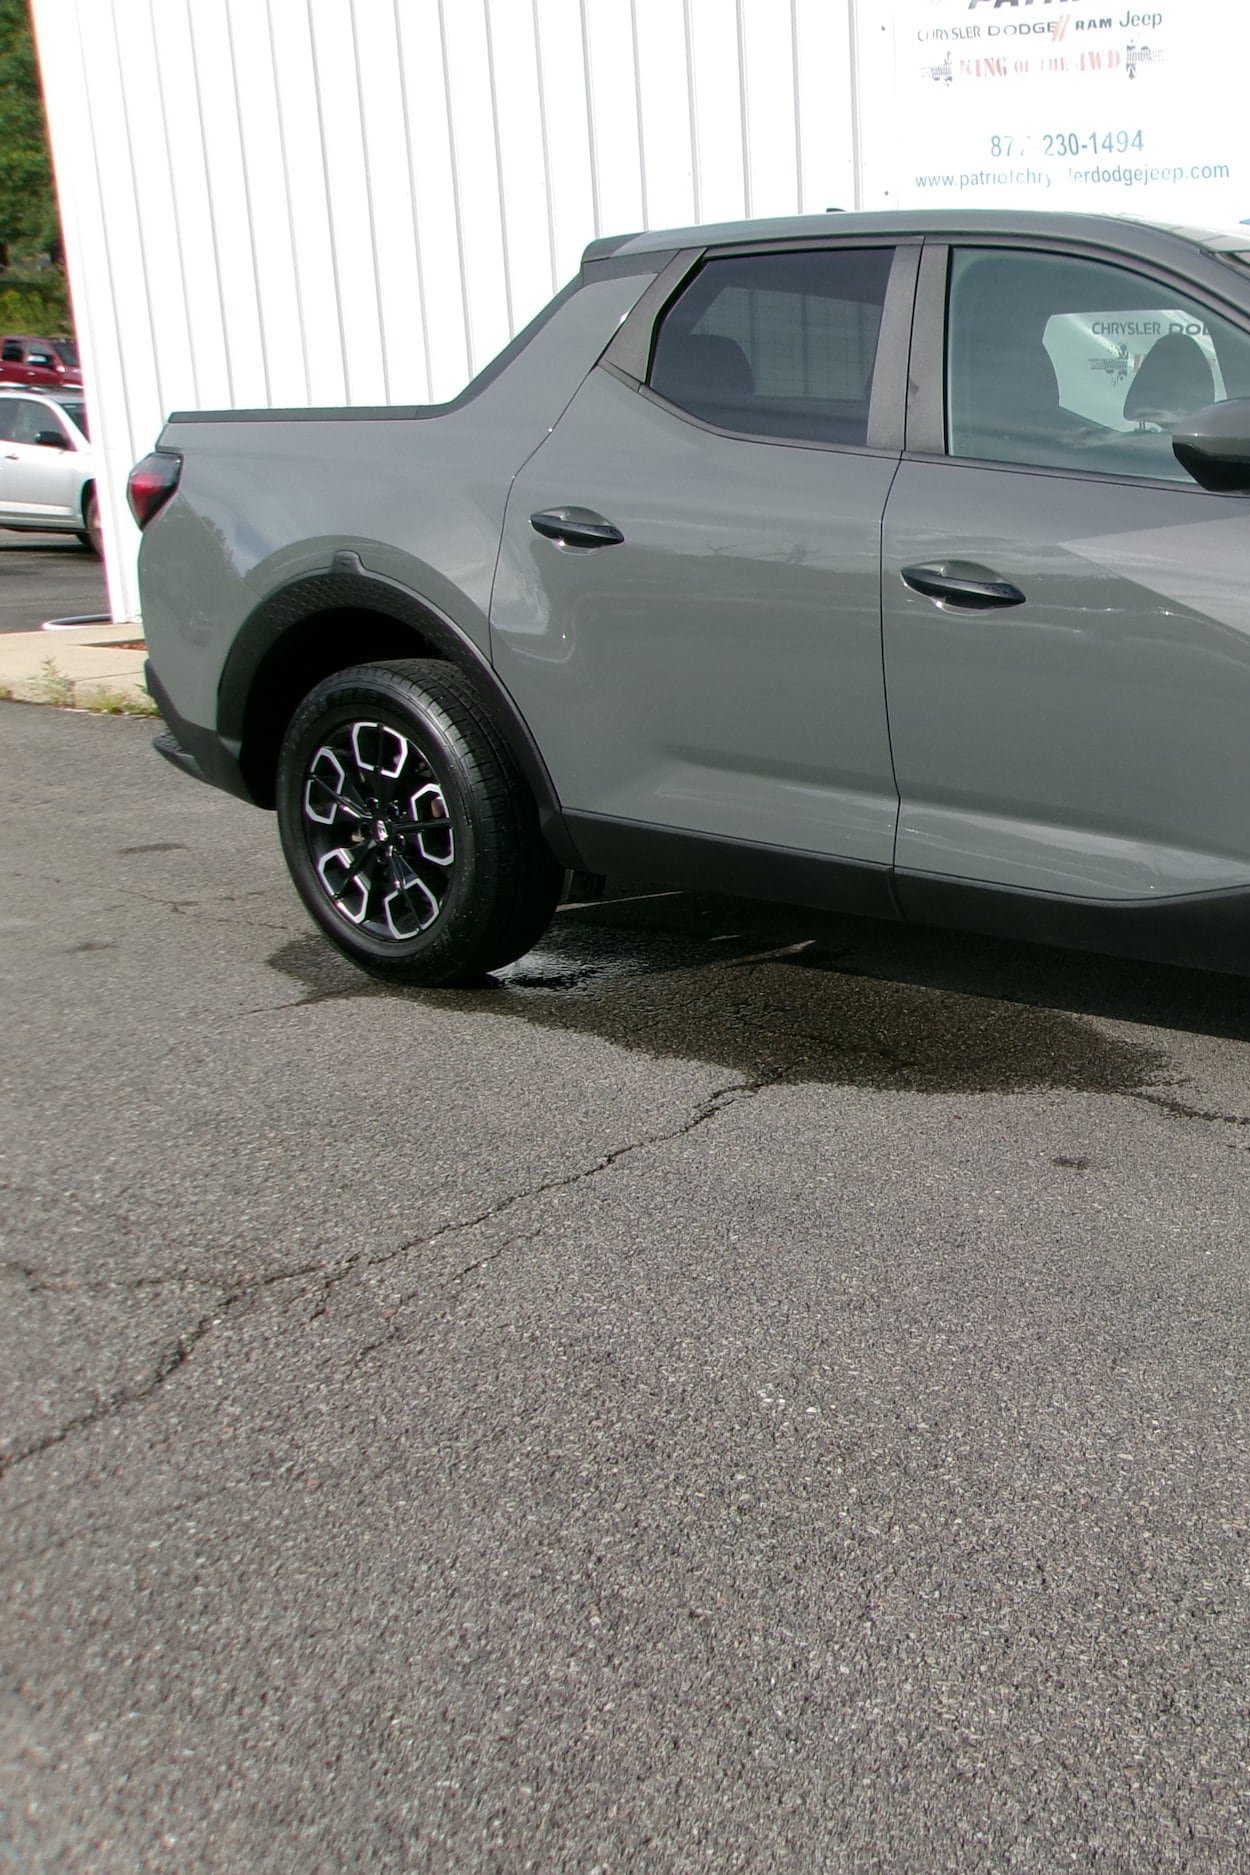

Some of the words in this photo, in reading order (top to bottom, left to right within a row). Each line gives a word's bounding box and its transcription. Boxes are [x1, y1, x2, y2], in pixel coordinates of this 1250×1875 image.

[987, 21, 1058, 37] DODGE
[1075, 17, 1112, 32] RAM
[1119, 10, 1163, 30] Jeep
[1091, 321, 1161, 336] CHRYSLER
